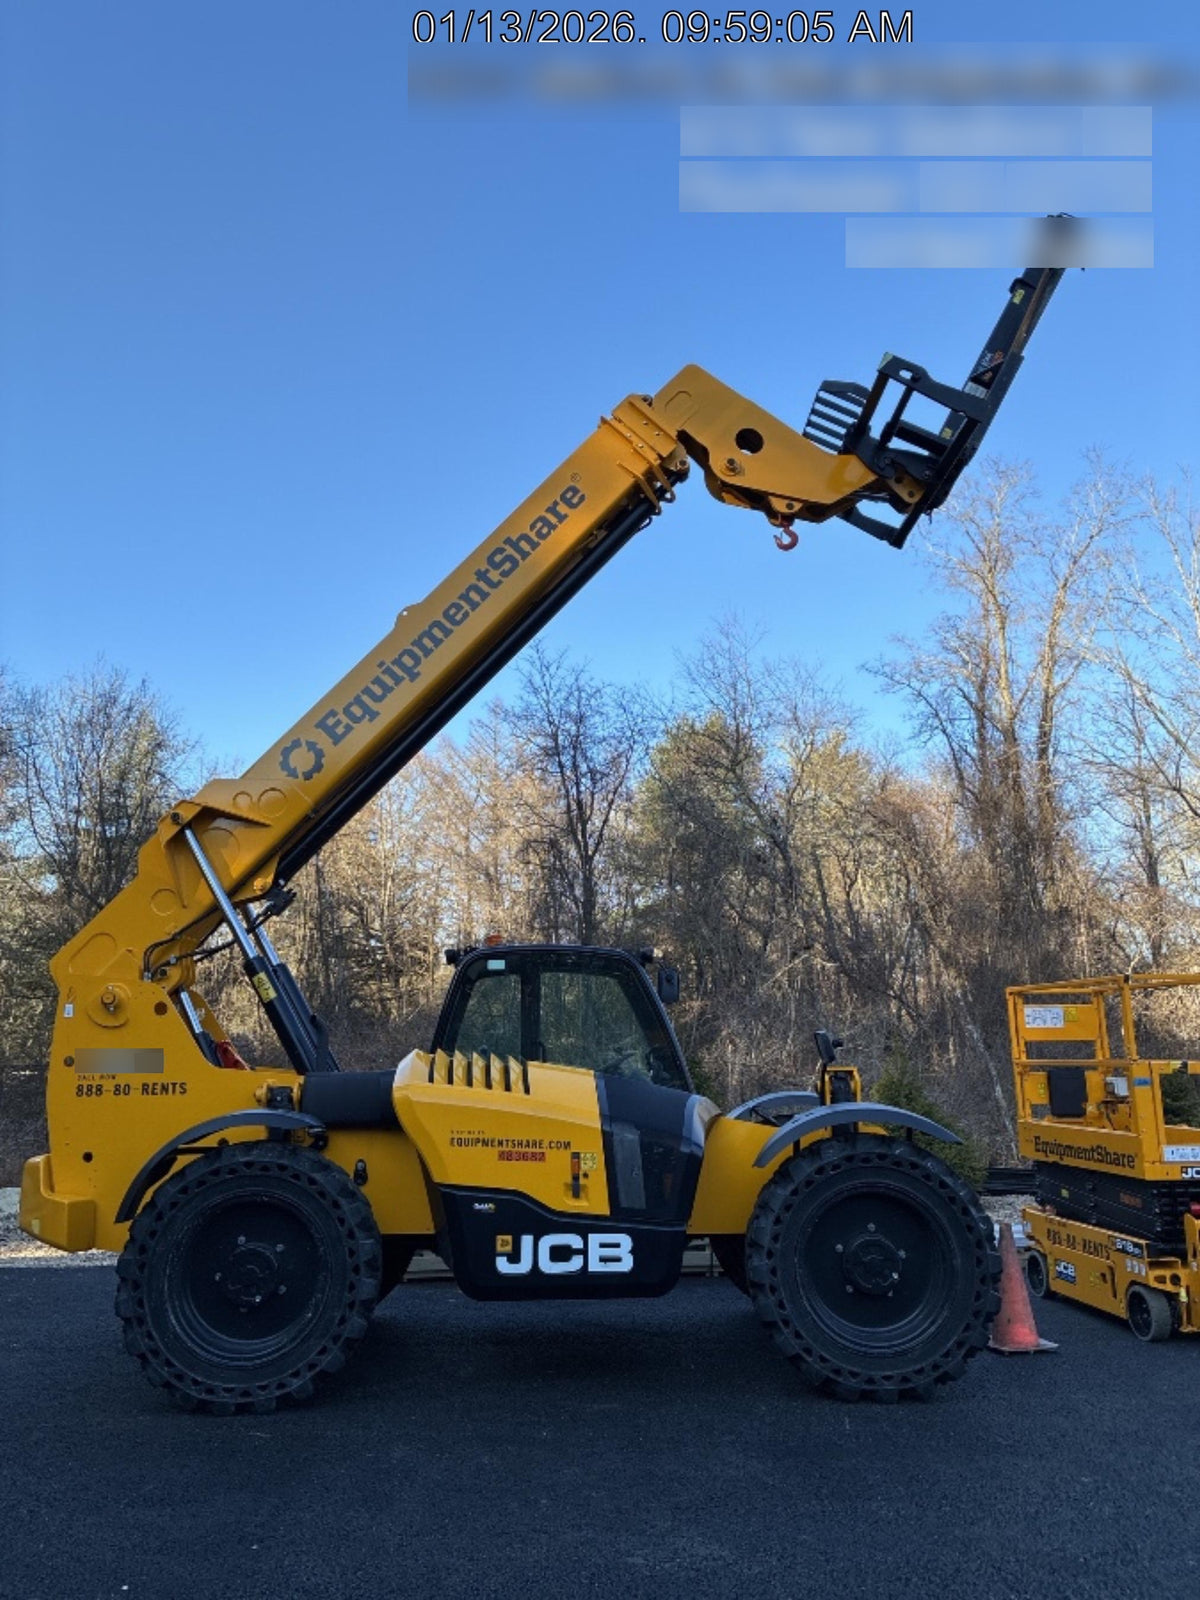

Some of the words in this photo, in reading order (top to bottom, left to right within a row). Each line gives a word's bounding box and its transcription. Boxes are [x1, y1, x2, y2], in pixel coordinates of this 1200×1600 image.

[76, 1082, 188, 1097] 888-80-RENTS
[450, 1137, 571, 1150] EQUIPMENTSHARE.COM
[495, 1233, 634, 1274] JCB
